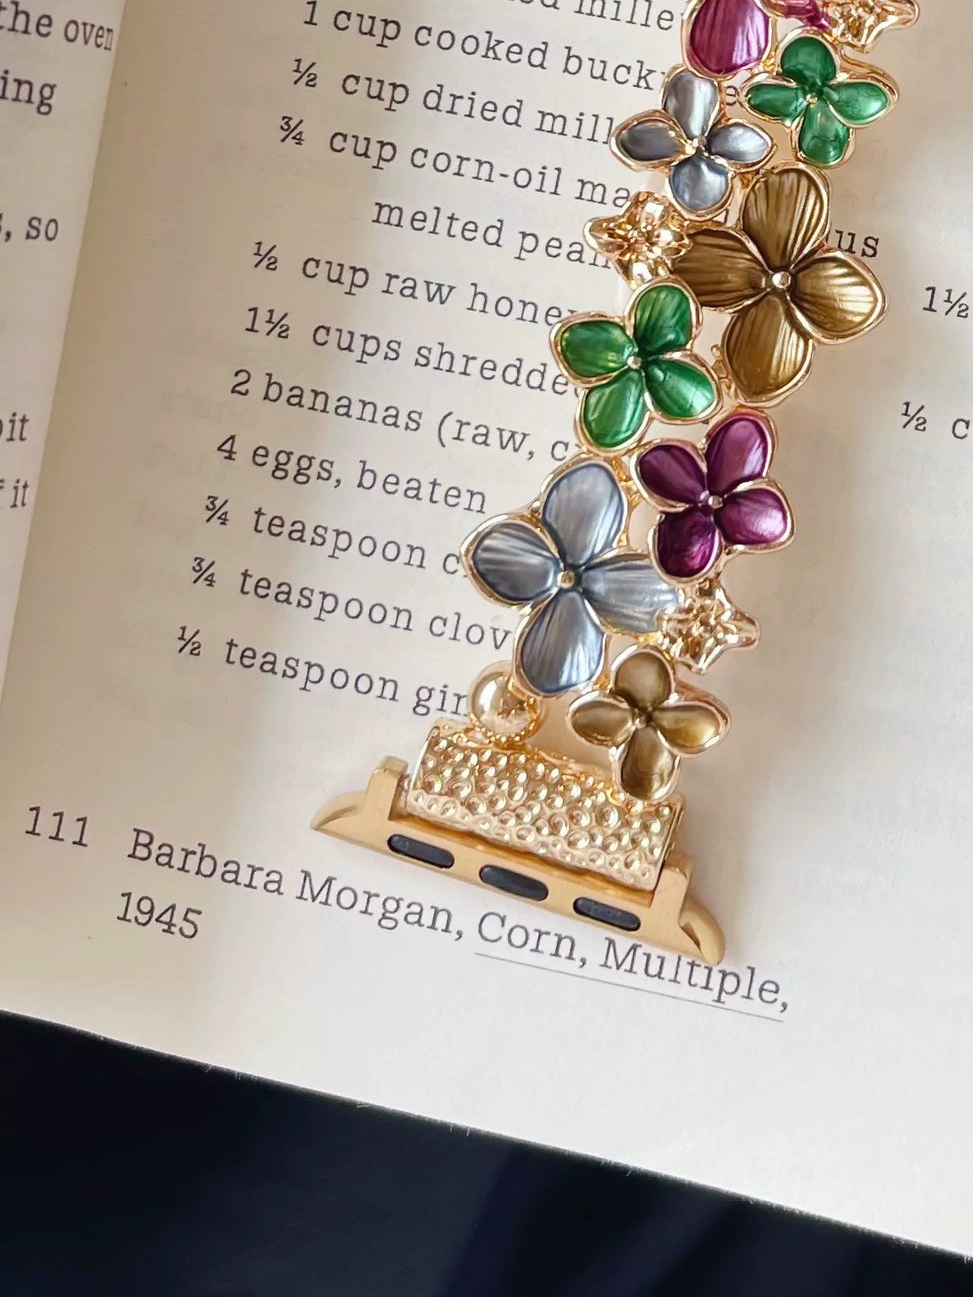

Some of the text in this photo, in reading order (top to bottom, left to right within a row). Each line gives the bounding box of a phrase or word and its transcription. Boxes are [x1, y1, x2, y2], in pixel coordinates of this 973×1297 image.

[63, 19, 114, 51] oven
[341, 73, 524, 128] cup dried
[329, 131, 563, 197] cup corn-oil
[371, 201, 505, 248] melted
[301, 257, 457, 306] cup raw
[312, 324, 402, 365] cups
[262, 372, 535, 461] bananas (raw,
[251, 445, 486, 515] eggs, beaten
[253, 506, 427, 570] teaspoon
[225, 638, 399, 703] teaspoon
[24, 805, 789, 1014] 111 Barbara Morgan, Corn, Multiple,
[116, 891, 203, 940] 1945
